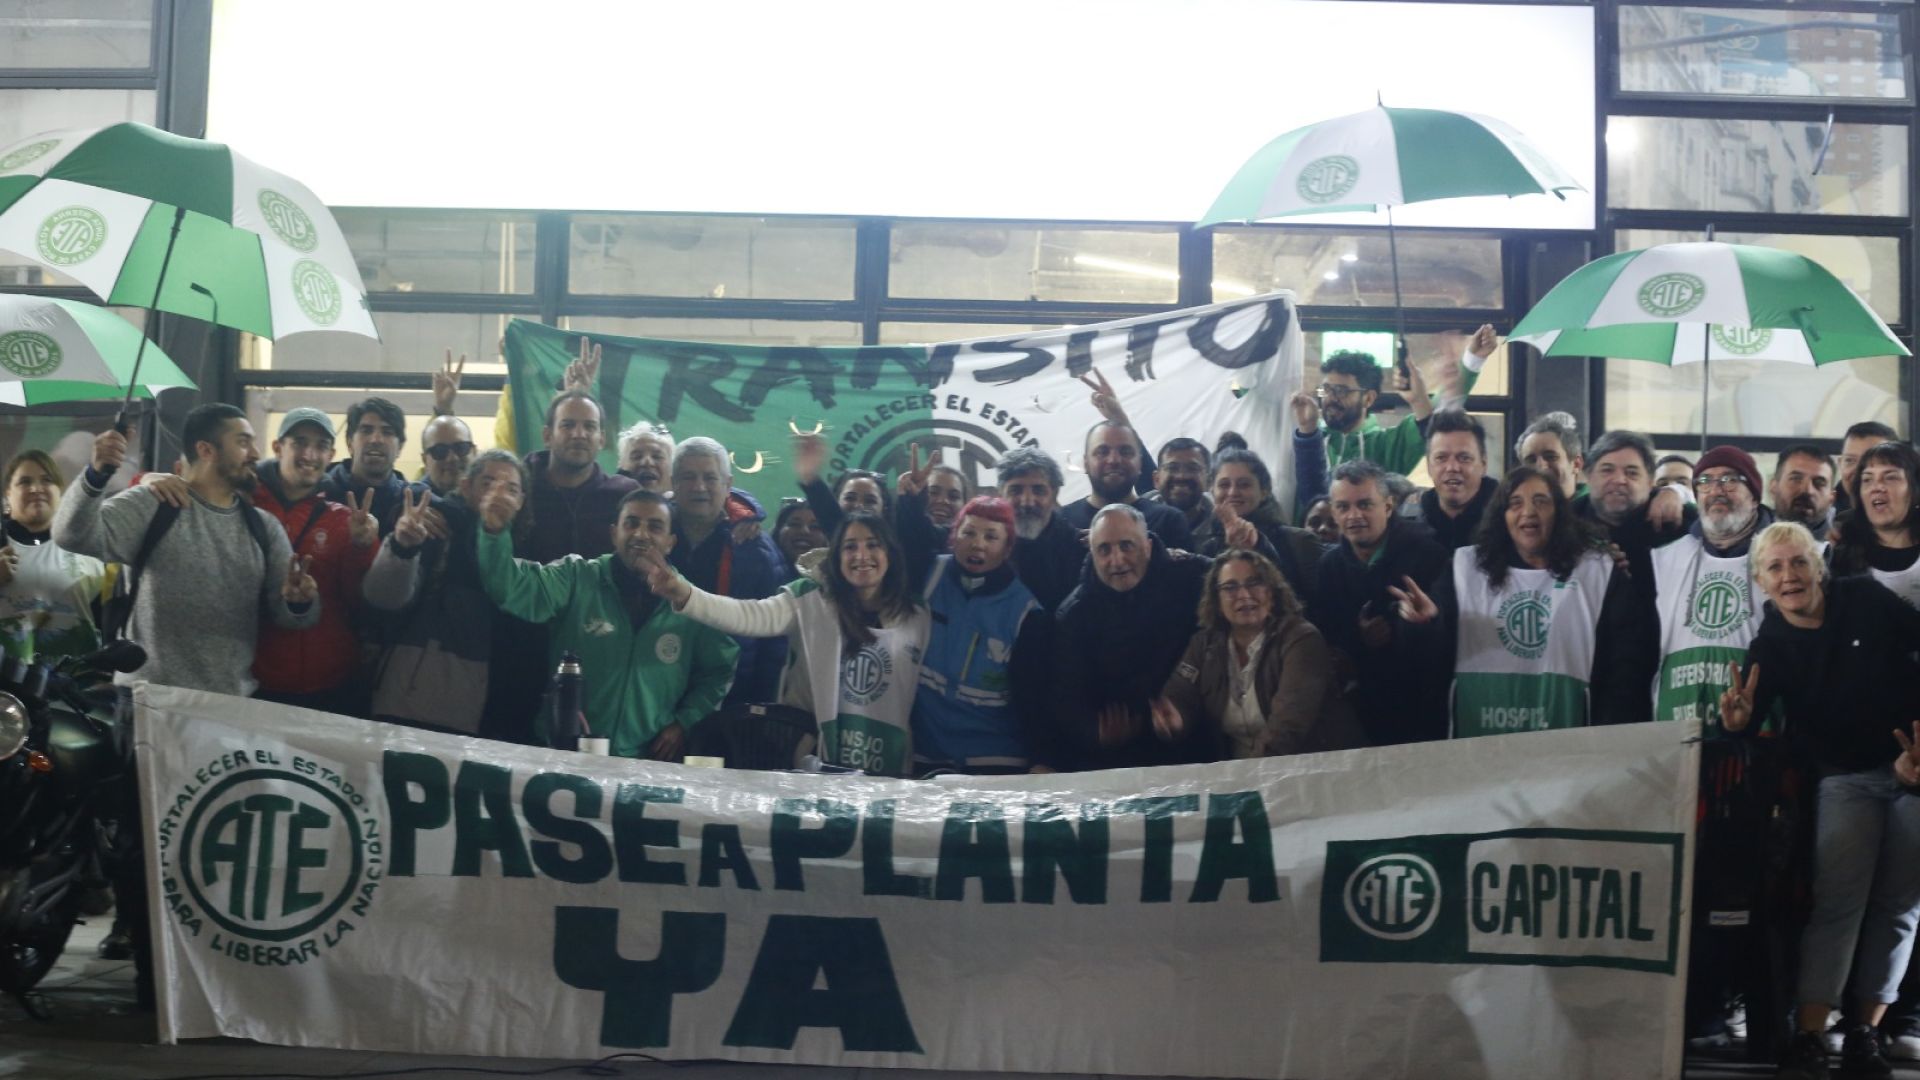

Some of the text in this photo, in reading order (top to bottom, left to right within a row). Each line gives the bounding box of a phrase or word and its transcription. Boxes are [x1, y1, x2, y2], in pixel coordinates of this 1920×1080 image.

[1653, 282, 1691, 306] ATE
[10, 340, 46, 366] ATE
[563, 297, 1291, 435] TRANSITO
[946, 394, 971, 413] EL
[1512, 605, 1547, 642] ATE
[1699, 586, 1734, 624] ATE
[847, 654, 878, 690] ATE
[256, 750, 281, 765] EL
[383, 750, 1281, 904] PASE A PLANTA
[201, 793, 331, 921] ATE
[1359, 864, 1425, 925] ATE
[1471, 861, 1655, 941] CAPITAL
[211, 934, 319, 966] LIBERAR
[323, 919, 355, 948] LA
[553, 905, 926, 1055] YA
